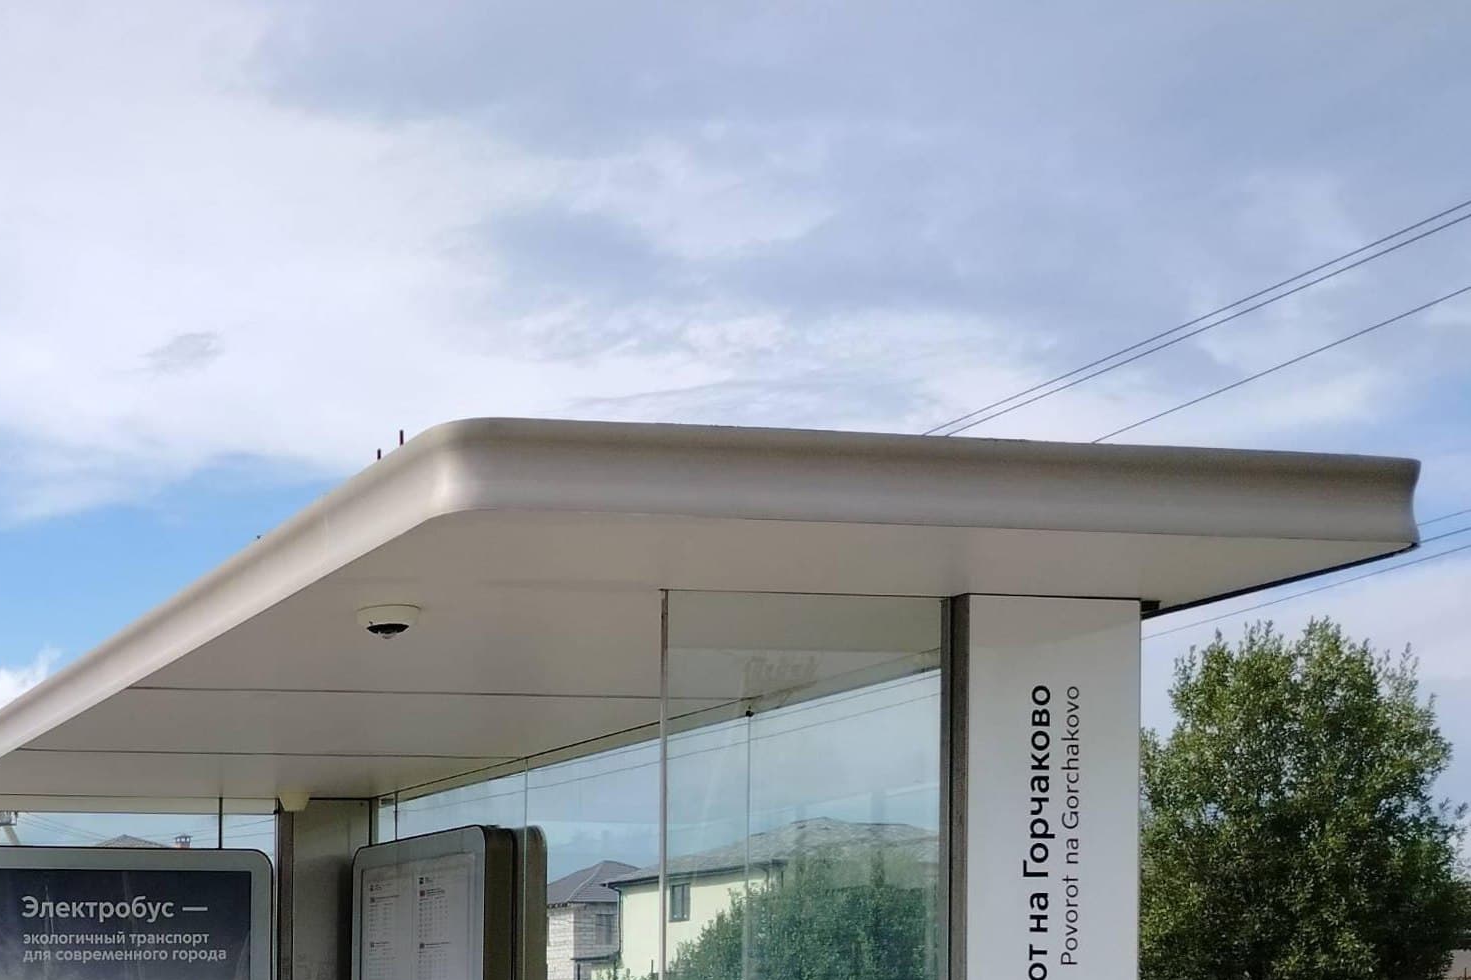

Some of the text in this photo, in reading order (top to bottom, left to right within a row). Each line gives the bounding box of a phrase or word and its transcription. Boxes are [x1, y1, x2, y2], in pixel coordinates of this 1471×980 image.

[1022, 684, 1055, 878] Горчаково
[1060, 685, 1080, 965] Povorot na Gorchakovo
[21, 895, 176, 923] Электробус
[1029, 891, 1049, 932] на
[22, 931, 210, 946] экологичный транспорт
[22, 950, 227, 964] для современного города
